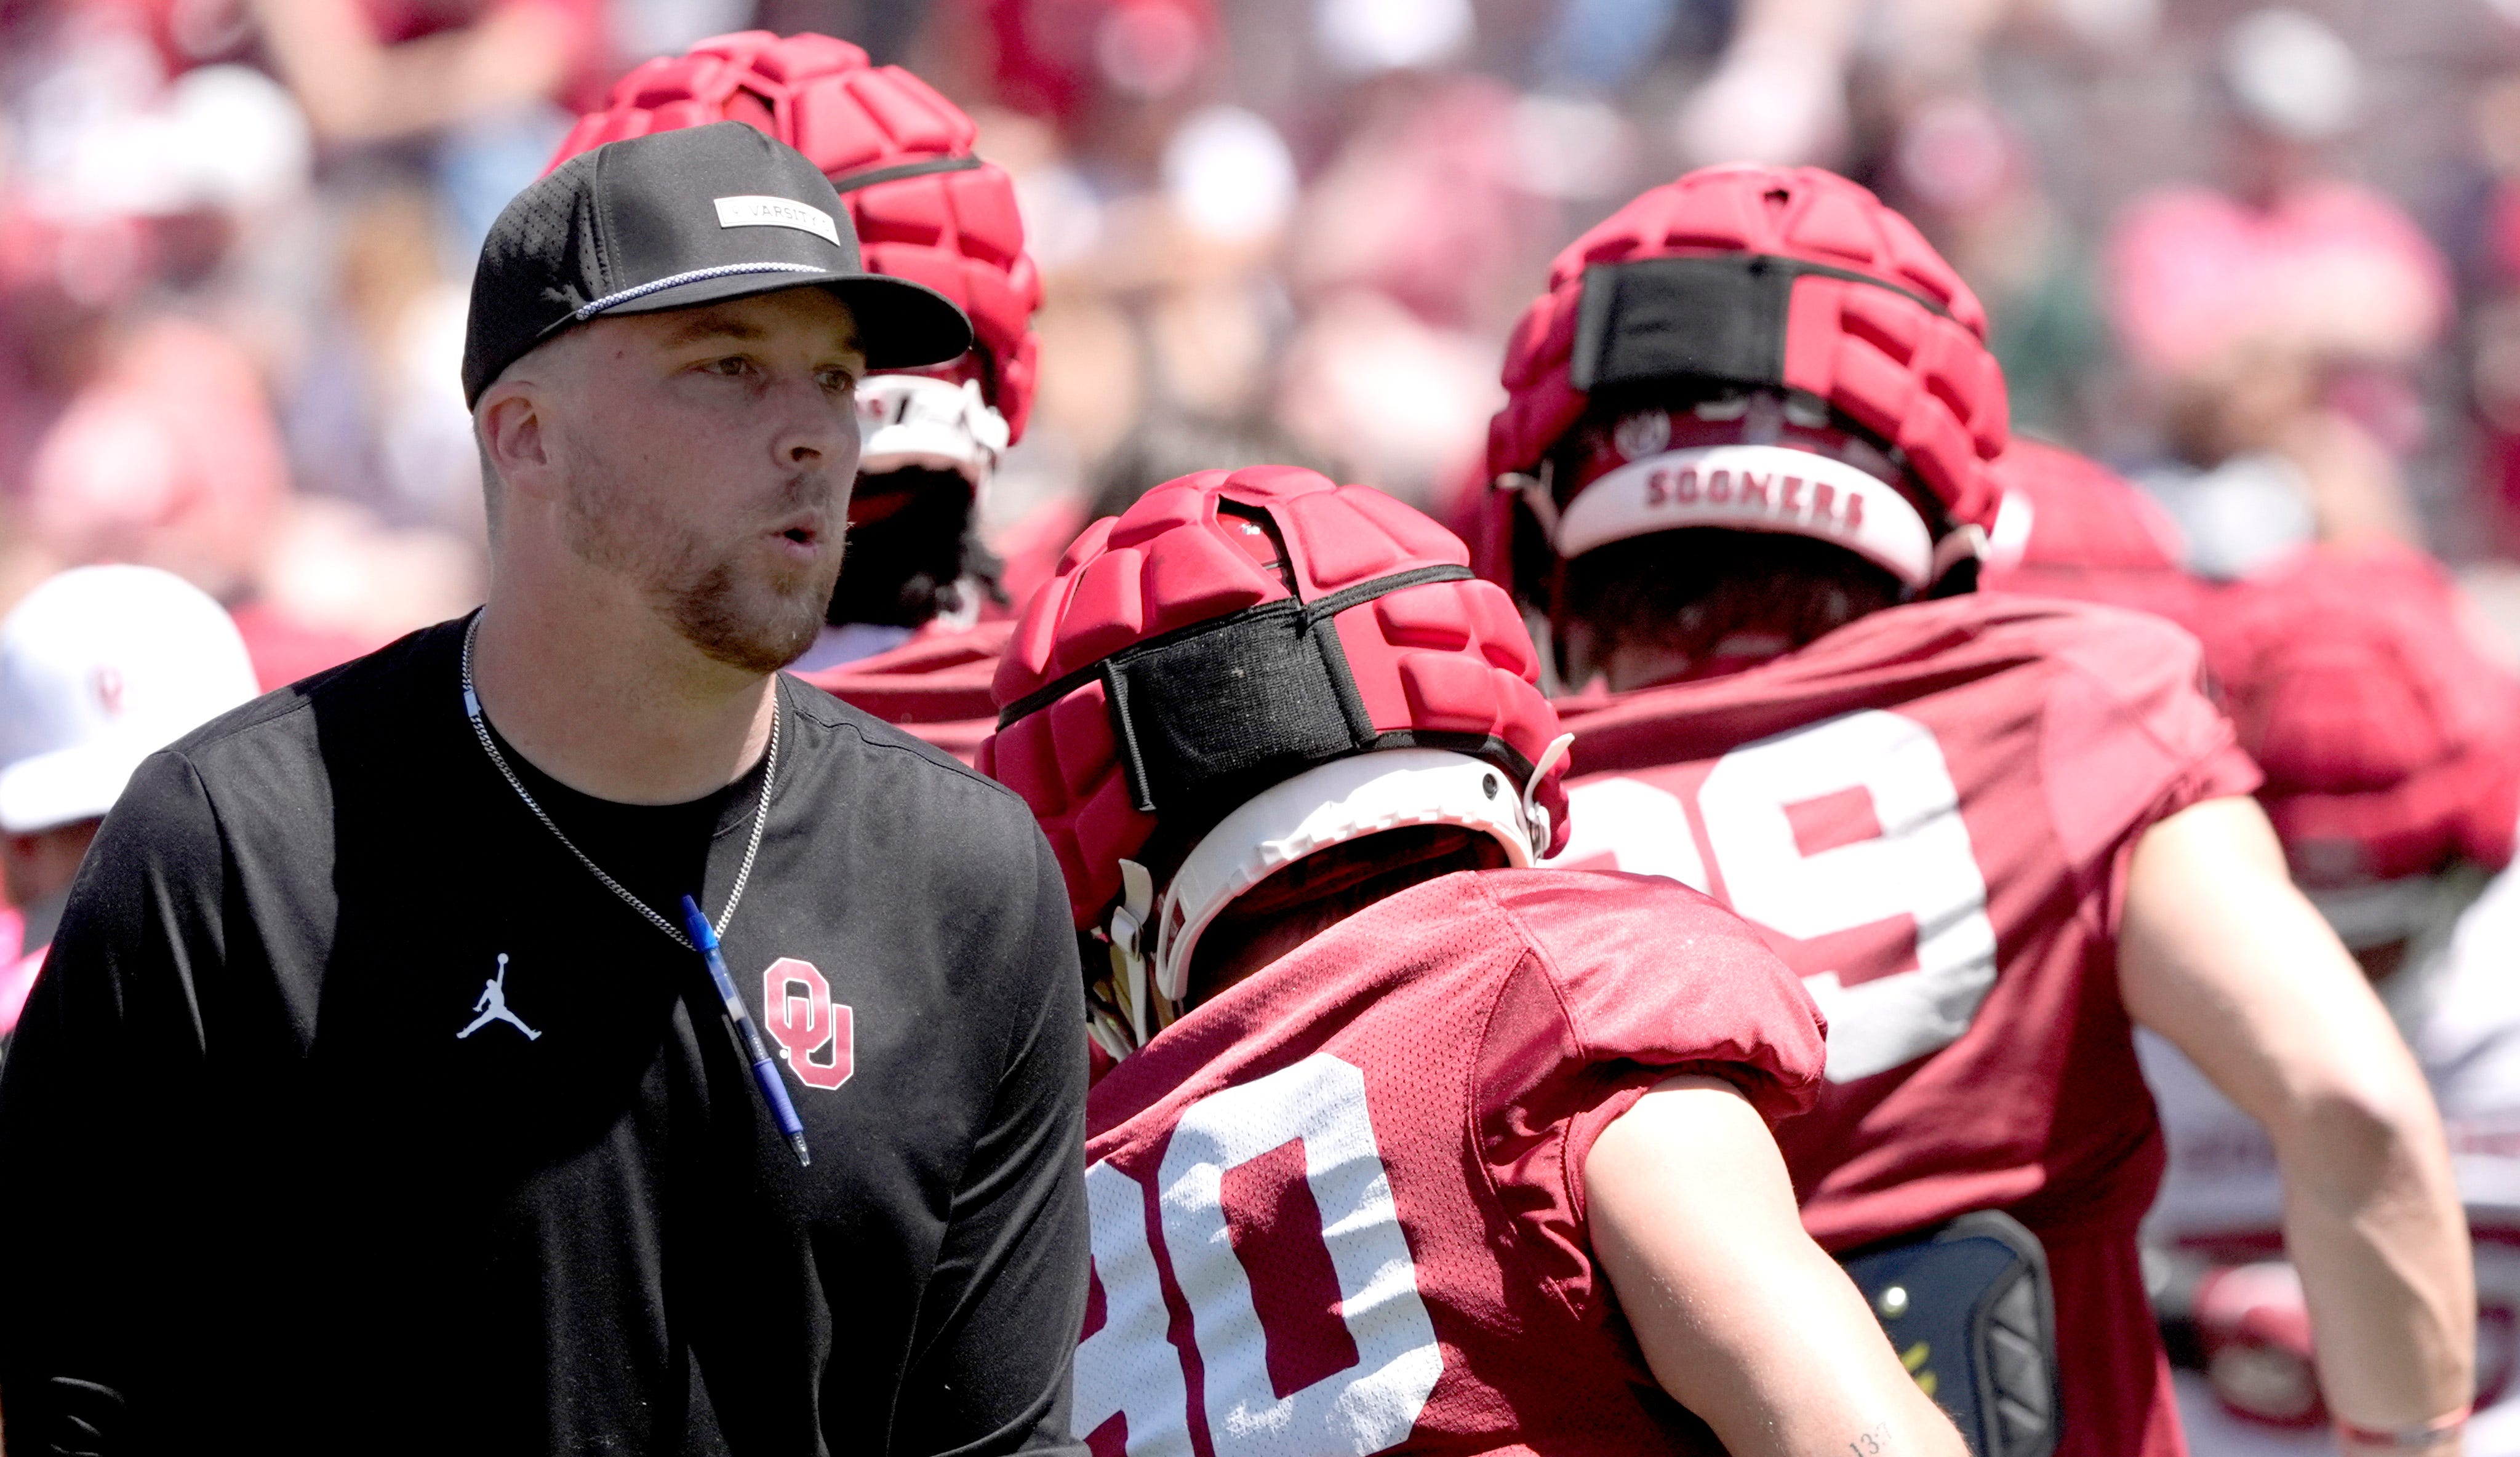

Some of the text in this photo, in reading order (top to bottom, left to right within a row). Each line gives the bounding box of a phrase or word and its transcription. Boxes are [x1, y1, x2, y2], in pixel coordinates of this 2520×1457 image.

[748, 204, 817, 226] VARSITY
[1647, 466, 1863, 529] SOONERS
[763, 957, 854, 1090] OU
